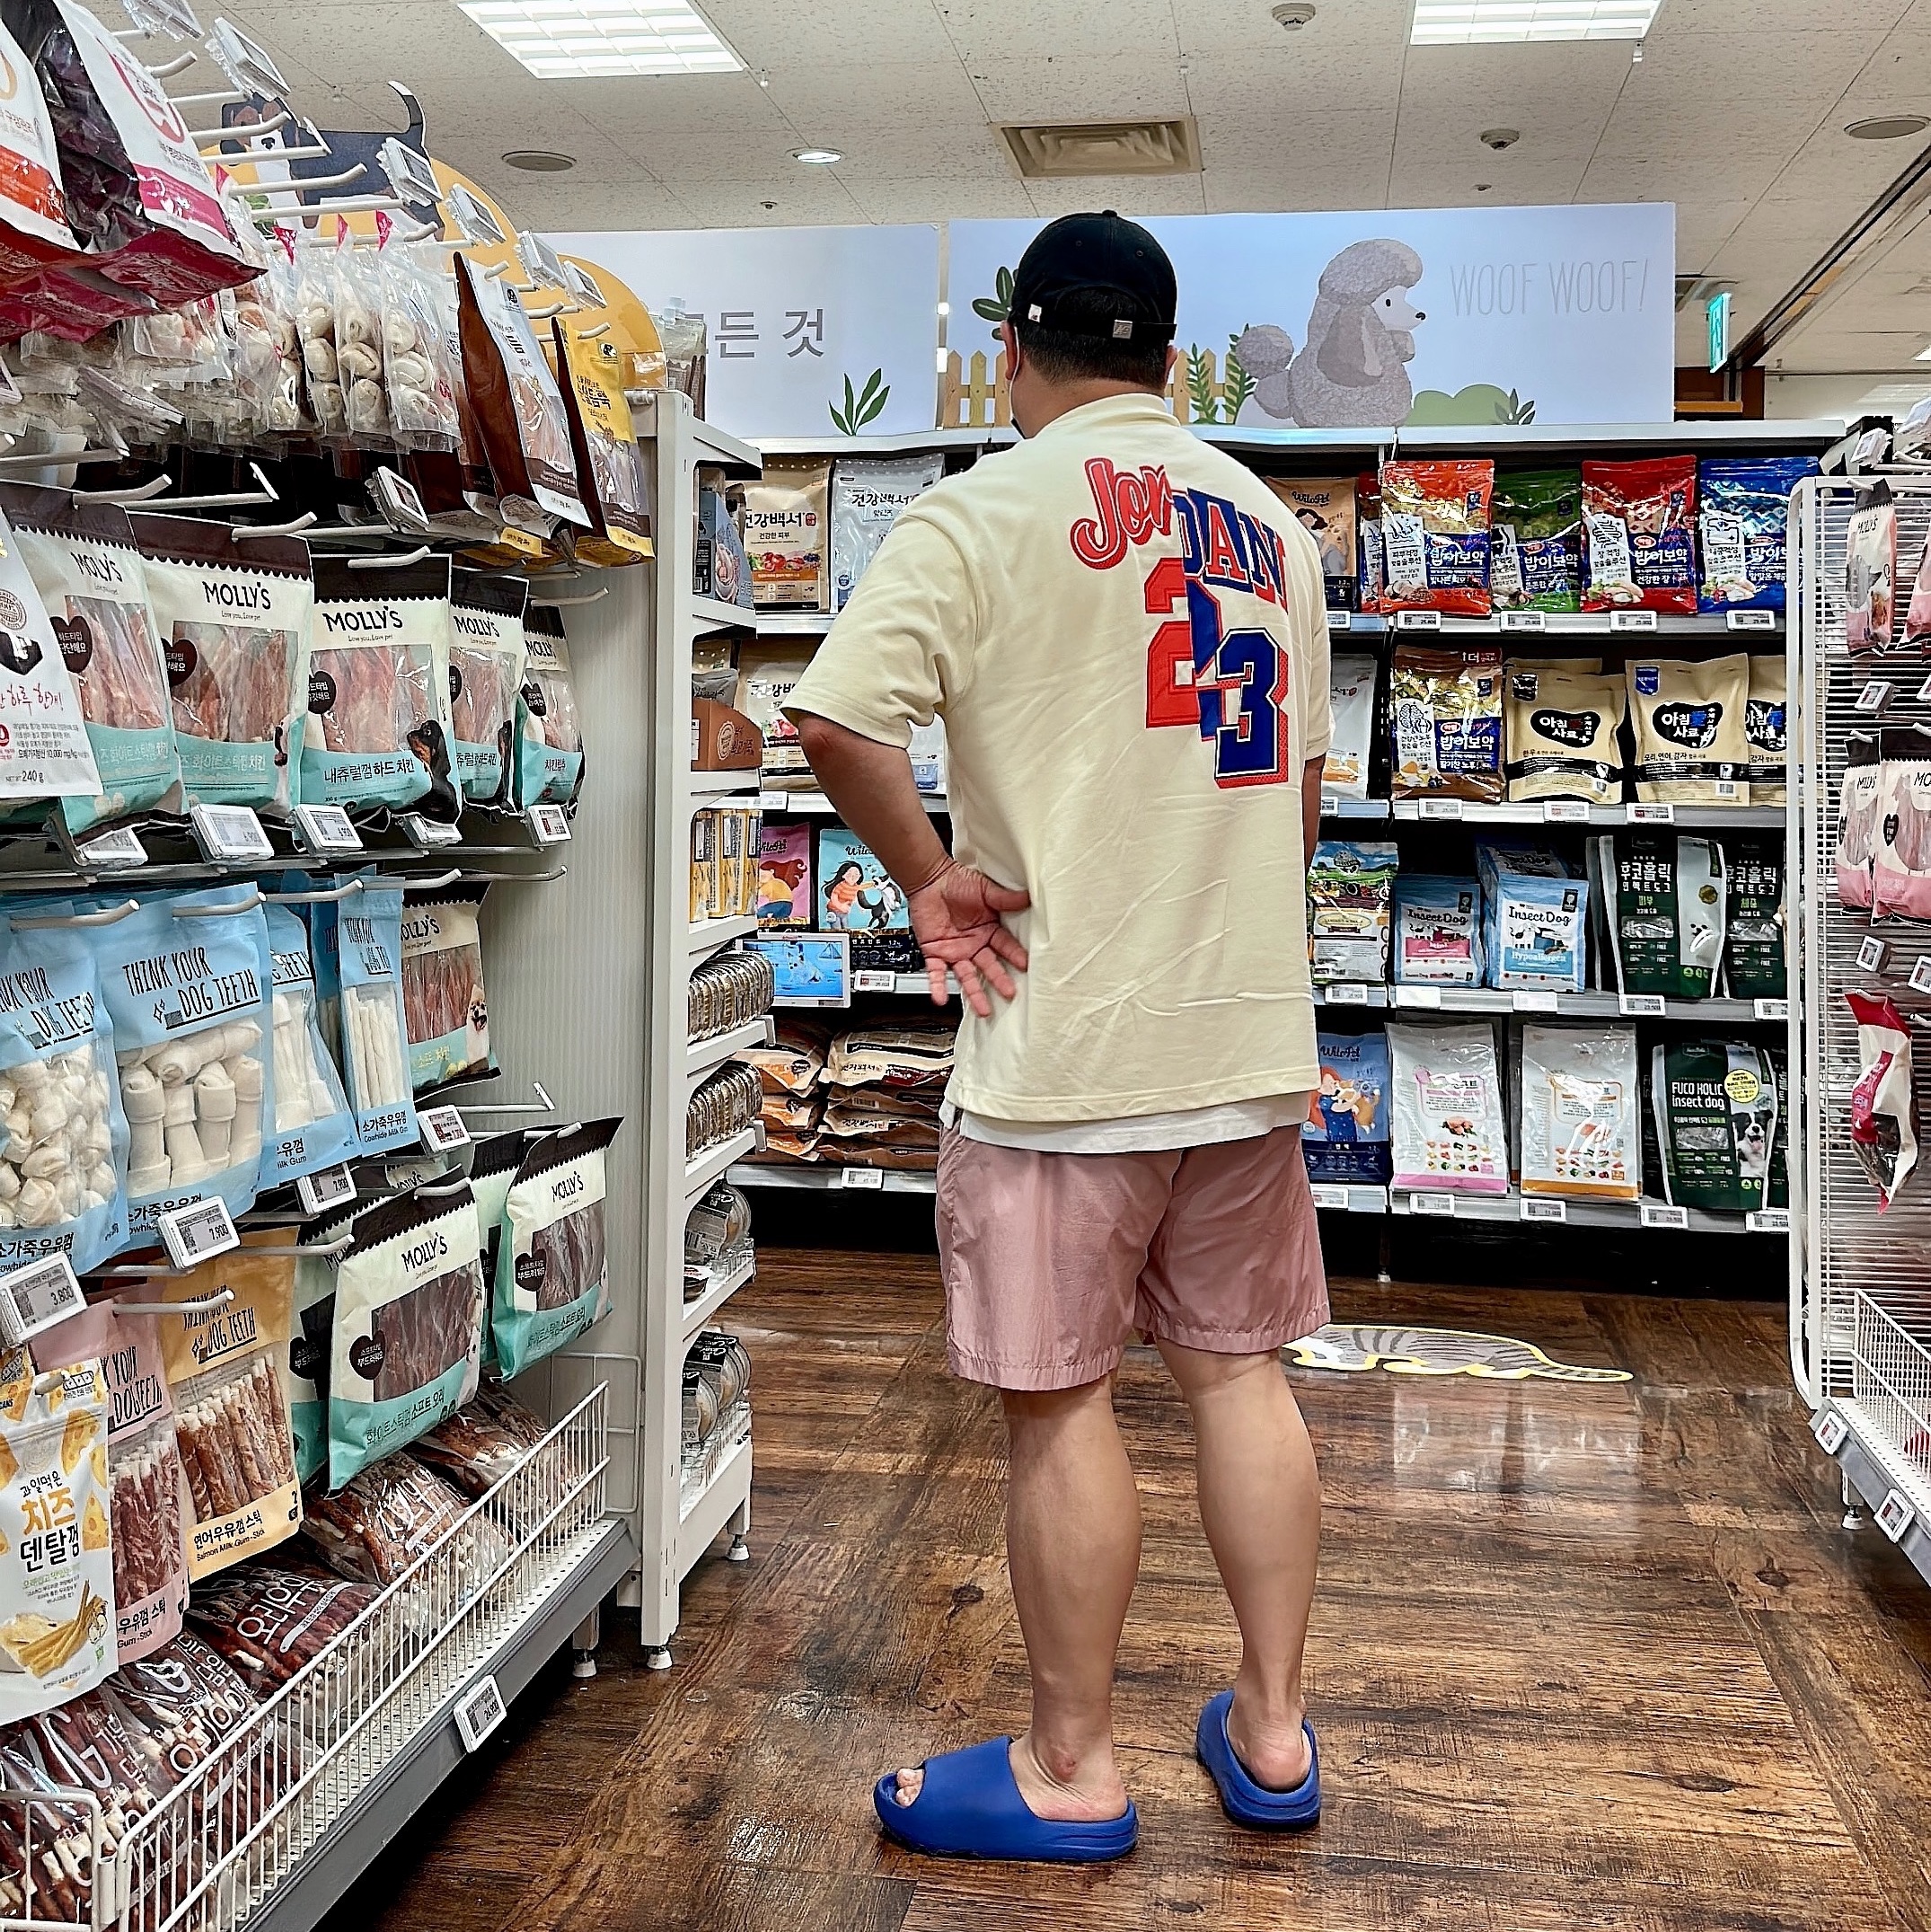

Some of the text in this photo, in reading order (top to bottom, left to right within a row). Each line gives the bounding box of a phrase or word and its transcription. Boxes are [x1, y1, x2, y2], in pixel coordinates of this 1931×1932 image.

[1449, 259, 1649, 316] WOOF WOOF!
[688, 308, 825, 358] 든 것
[1430, 551, 1486, 567] 밥이보약
[1524, 553, 1579, 572] 밥이보약
[1635, 549, 1688, 566] 밥이보약
[1636, 576, 1660, 585] 건강한
[202, 580, 272, 610] MOLLY'S
[322, 605, 403, 632] MOLLY'S
[454, 614, 499, 638] MOLLY'S
[1144, 557, 1289, 789] 23
[310, 682, 328, 693] 드타입
[1539, 716, 1579, 739] 아침 사료
[1662, 712, 1700, 738] 아침 사료
[1441, 735, 1495, 751] 밥이보약
[22, 771, 38, 782] 240
[1621, 862, 1671, 882] 후코홀릭
[401, 914, 441, 941] OLLY'S
[122, 947, 214, 997] THINK YOUR
[178, 968, 259, 1018] DOG TEETH
[1671, 1081, 1696, 1095] FUCO
[1697, 1082, 1724, 1097] HOLIC
[1671, 1095, 1725, 1111] insect dog
[289, 1154, 307, 1167] Gum
[551, 1170, 585, 1204] MOLLY'S
[401, 1232, 448, 1273] MOLLY'S
[51, 1285, 75, 1307] 3,800
[228, 1307, 258, 1344] TEETH
[20, 1470, 61, 1496] 과일먹은
[21, 1487, 76, 1536] 치즈
[194, 1509, 263, 1551] 연어우유껌 스틱
[20, 1522, 81, 1574] 덴탈껌
[151, 1597, 167, 1621] 스틱
